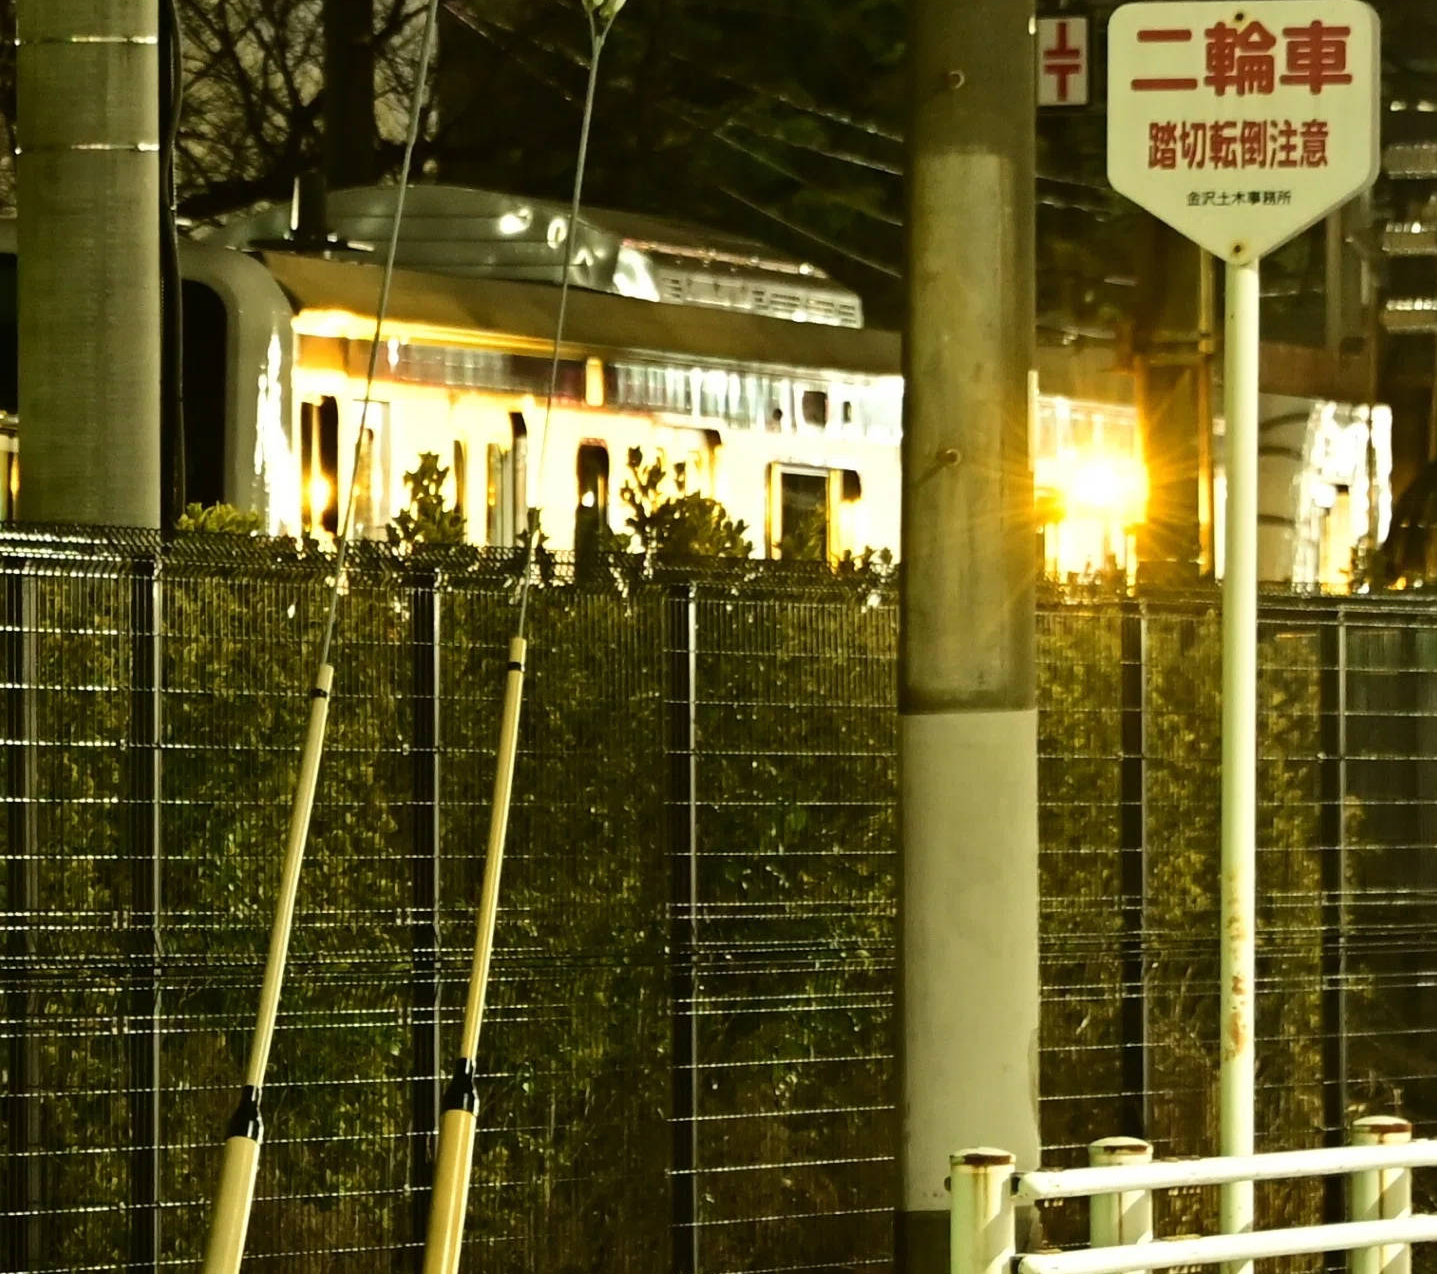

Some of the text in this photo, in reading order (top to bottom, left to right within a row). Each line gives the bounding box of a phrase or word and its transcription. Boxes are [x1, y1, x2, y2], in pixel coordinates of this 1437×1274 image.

[1131, 20, 1353, 96] 二輪車
[1148, 119, 1329, 170] 踏切転倒注意
[1187, 190, 1293, 207] 金沢土木事務所
